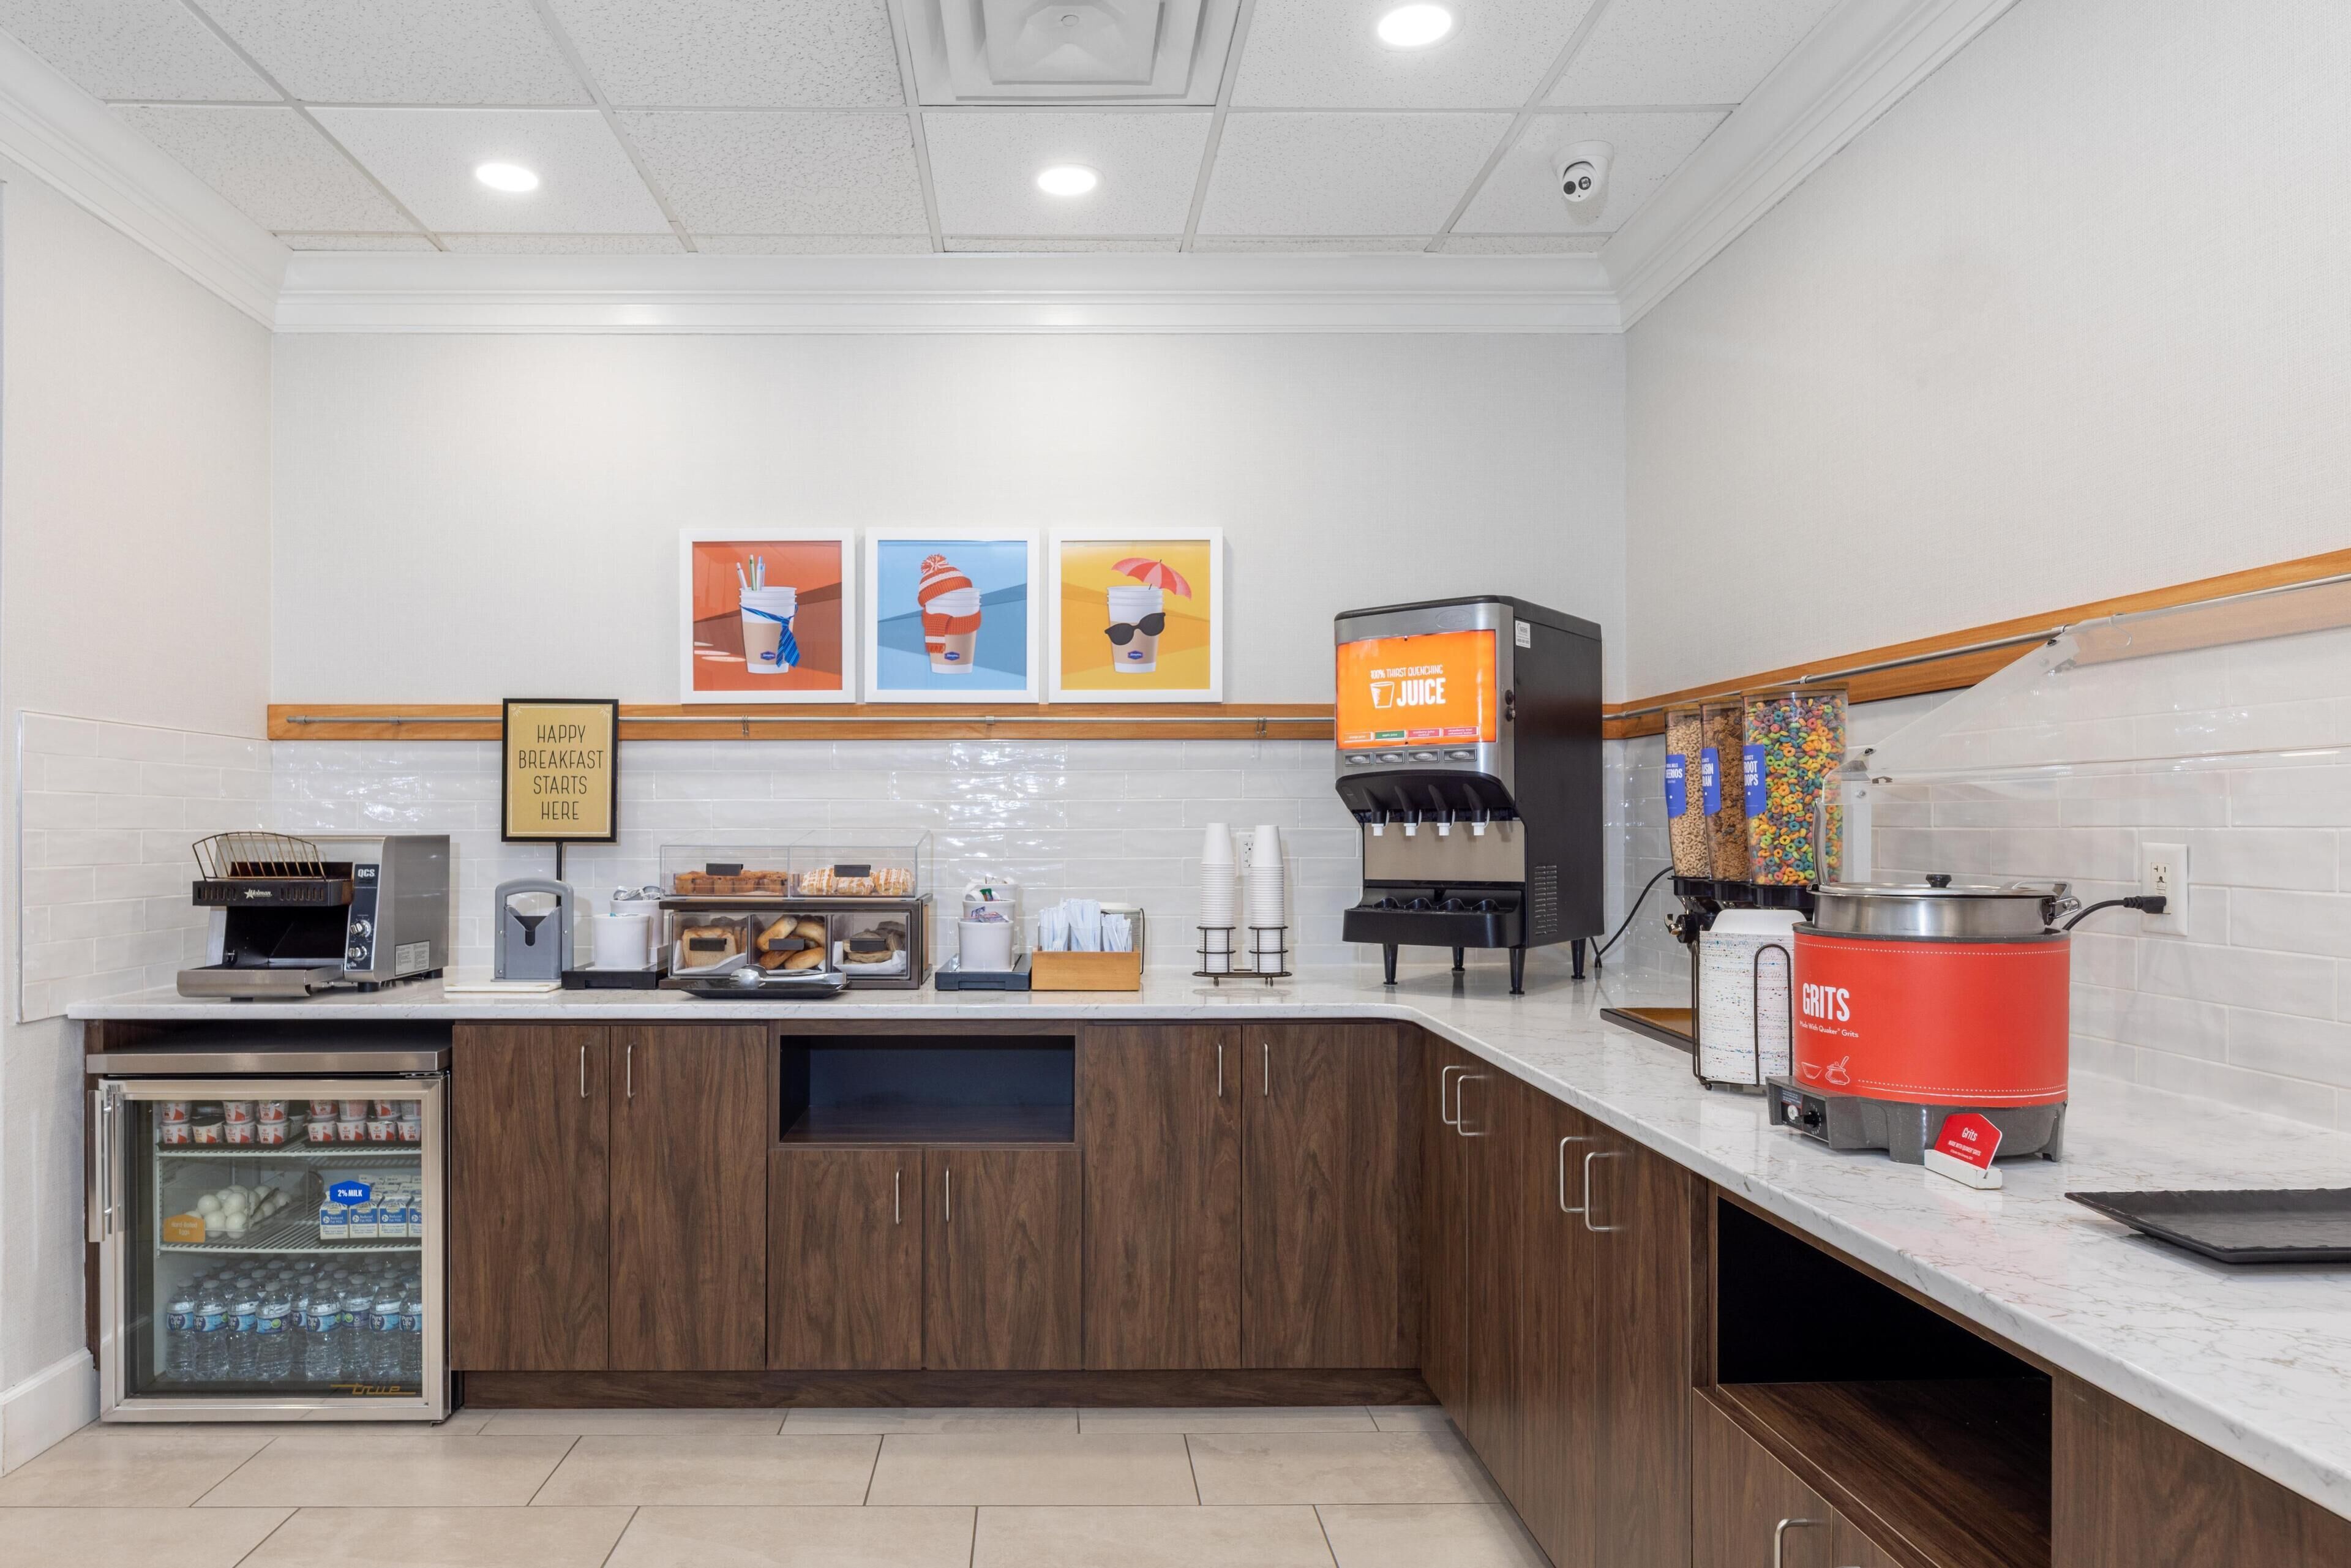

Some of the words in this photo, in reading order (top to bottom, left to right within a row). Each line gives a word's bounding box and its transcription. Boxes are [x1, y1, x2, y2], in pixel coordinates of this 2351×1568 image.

[1370, 669, 1385, 679] 100%
[1386, 667, 1406, 678] THIRST
[1408, 664, 1443, 677] QUENCHING
[1397, 677, 1446, 707] JUICE
[537, 724, 586, 743] HAPPY
[519, 750, 604, 769] BREAKFAST
[1744, 761, 1758, 774] ROOT
[533, 776, 587, 794] STARTS
[1744, 773, 1758, 786] OOPS
[541, 801, 579, 820] HERE
[358, 868, 375, 878] QCS
[1802, 982, 1850, 1022] GRITS
[1842, 1029, 1859, 1038] Grits
[1962, 1127, 1978, 1142] Grits
[331, 1382, 416, 1395] true
